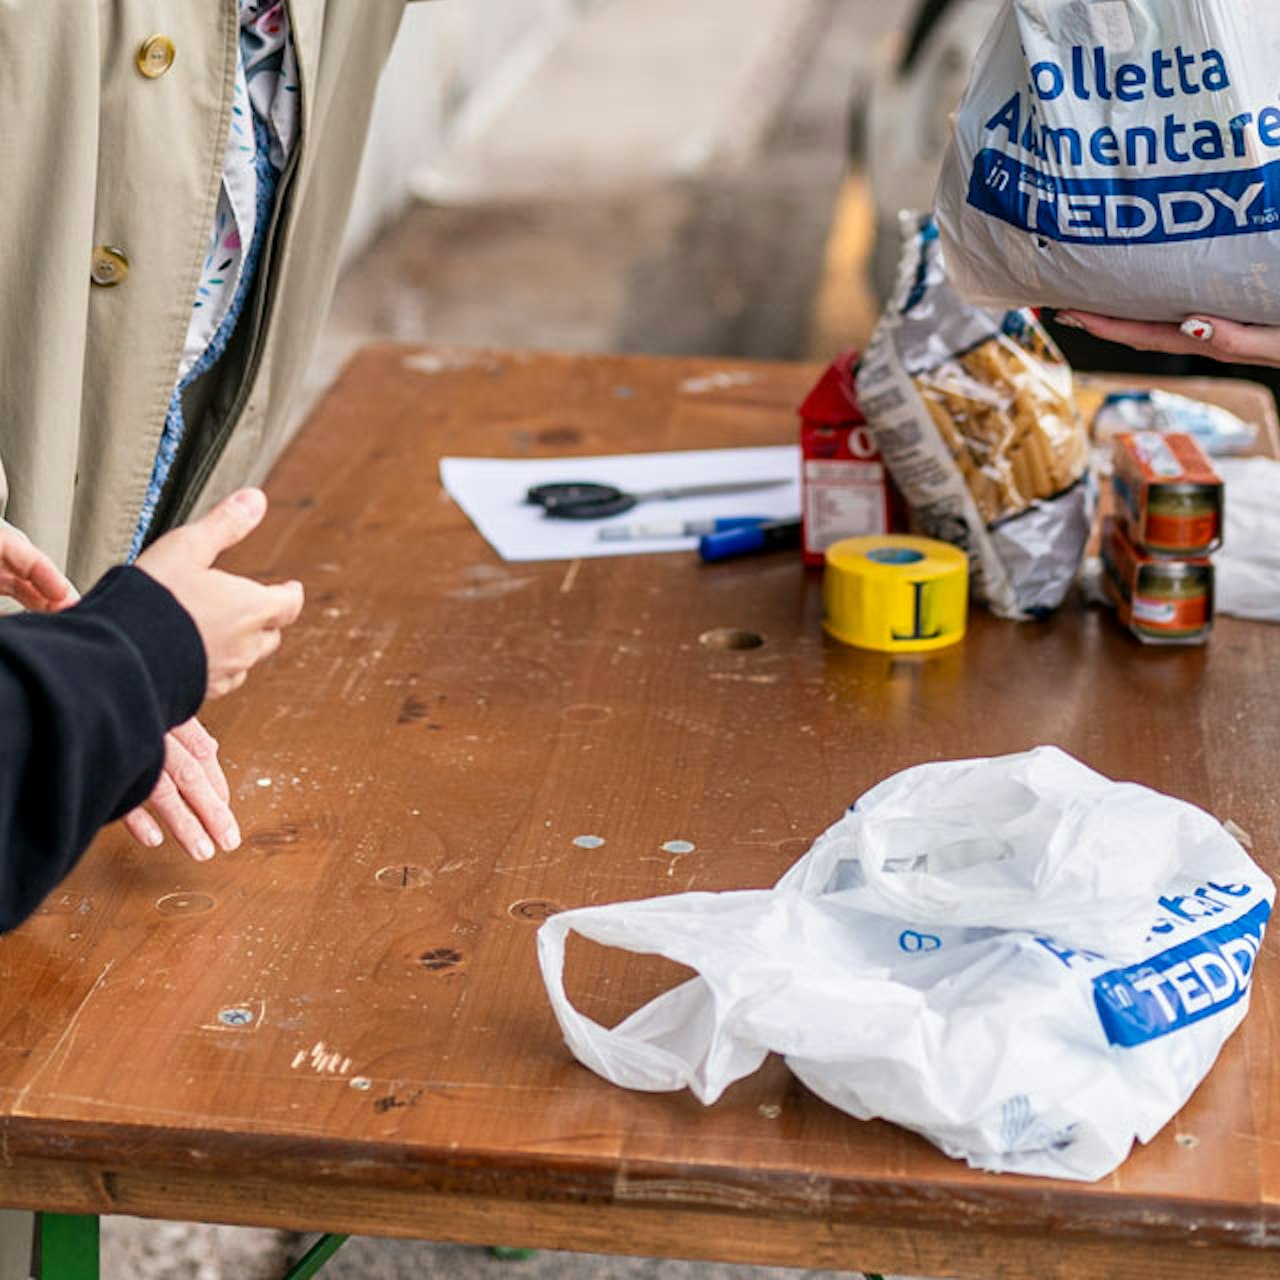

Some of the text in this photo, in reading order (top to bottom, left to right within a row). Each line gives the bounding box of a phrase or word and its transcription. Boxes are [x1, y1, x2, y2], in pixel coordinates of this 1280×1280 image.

[1022, 45, 1231, 102] olletta
[984, 158, 1010, 193] in
[1018, 181, 1266, 239] TEDDY
